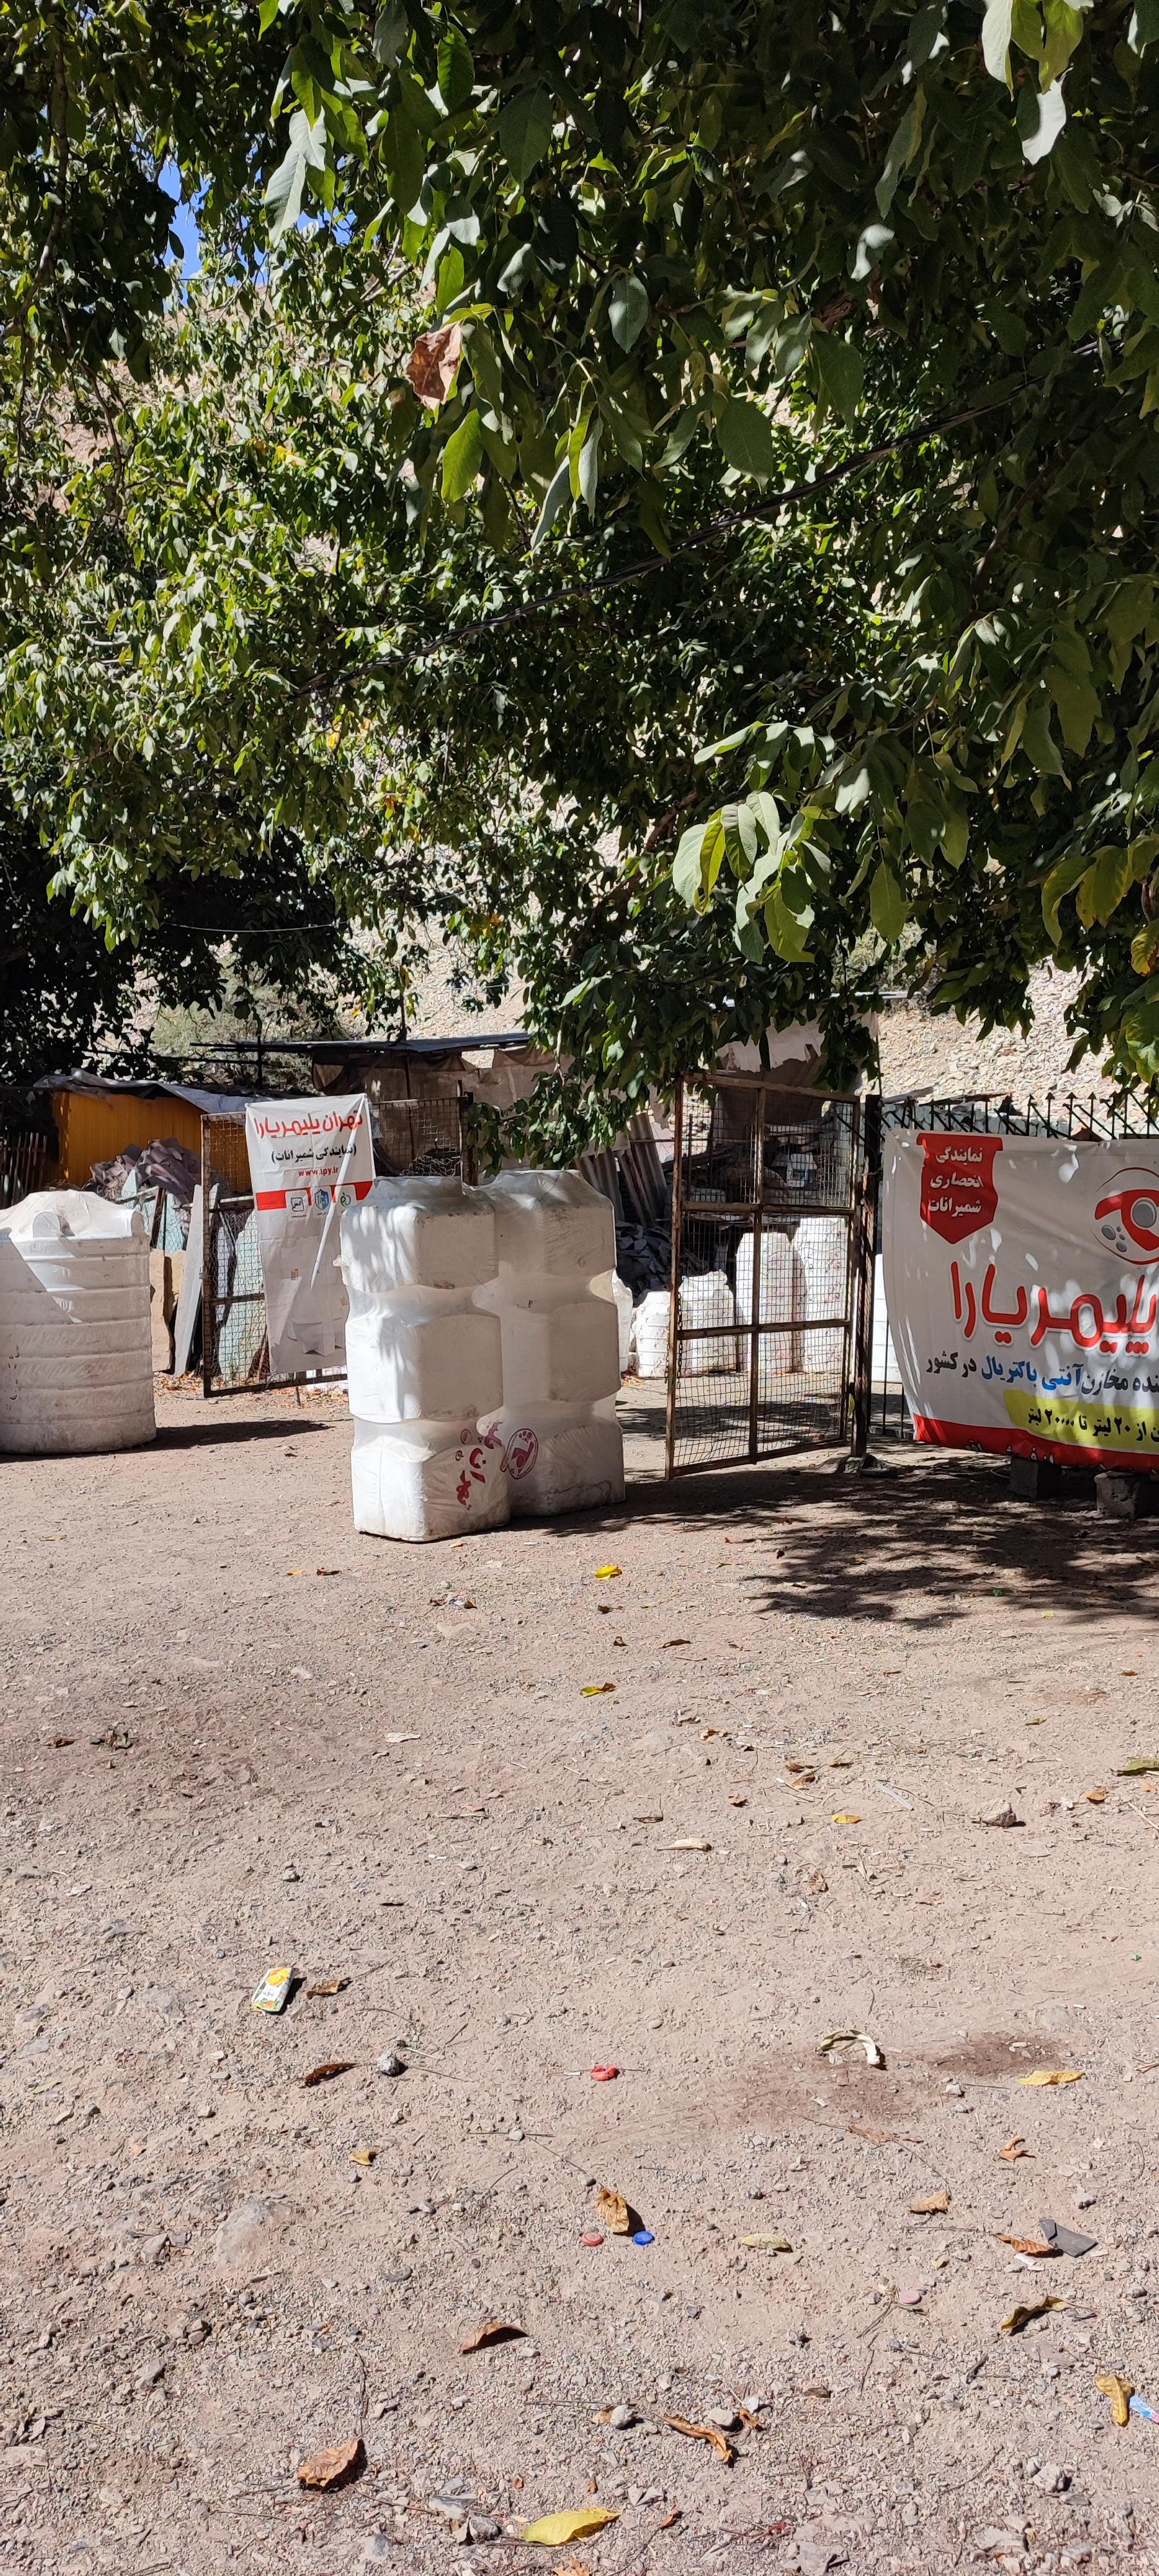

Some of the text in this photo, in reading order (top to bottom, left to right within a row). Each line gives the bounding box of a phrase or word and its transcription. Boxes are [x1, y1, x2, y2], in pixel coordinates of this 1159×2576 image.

[323, 1110, 363, 1132] تهران
[935, 1146, 983, 1165] نمایندگی
[930, 1171, 984, 1189] انحصاری
[928, 1197, 982, 1217] شمیرانات
[925, 1350, 959, 1374] کشور
[961, 1357, 977, 1378] در
[981, 1354, 1038, 1388] باکتریال
[1041, 1363, 1085, 1391] آنتی
[1080, 1368, 1129, 1396] مخازن
[1028, 1408, 1042, 1426] لیتر
[1078, 1414, 1088, 1430] تا
[1092, 1417, 1112, 1437] لیتر
[1113, 1417, 1131, 1435] ۲۰
[1135, 1421, 1147, 1441] از
